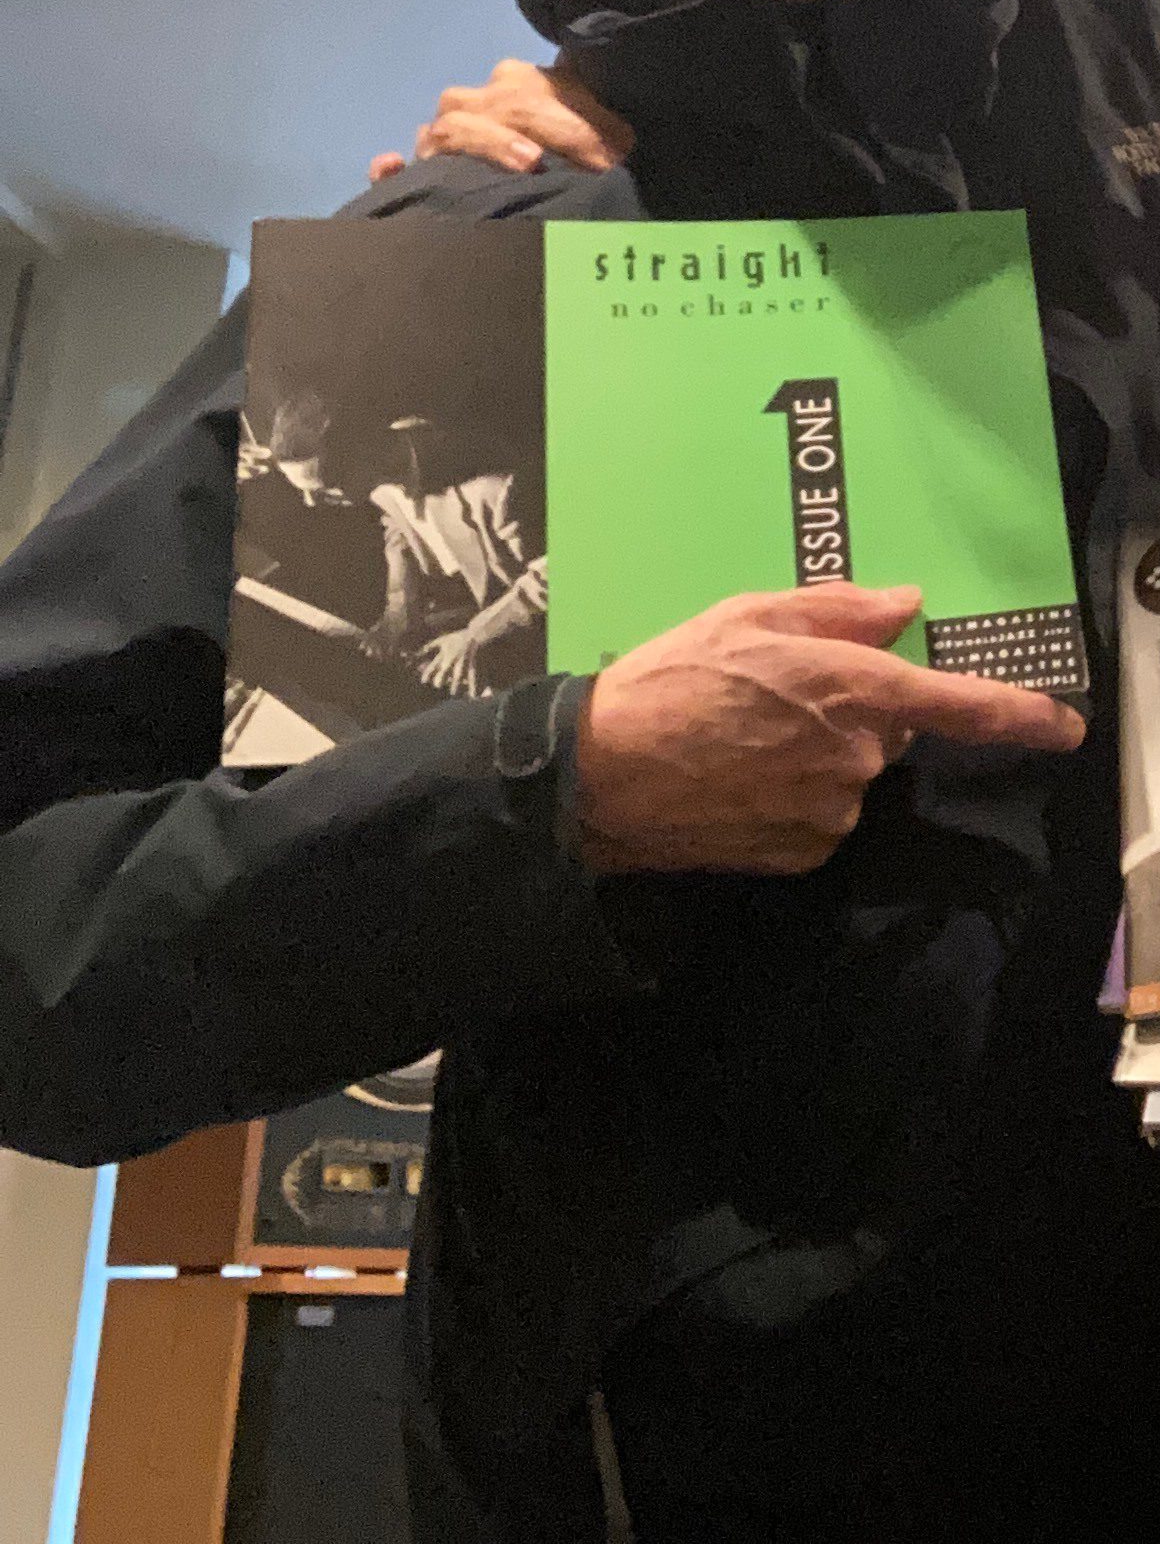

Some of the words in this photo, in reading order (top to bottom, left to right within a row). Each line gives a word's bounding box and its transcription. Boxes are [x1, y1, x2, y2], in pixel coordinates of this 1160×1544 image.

[594, 241, 829, 289] straight
[610, 302, 658, 318] no
[679, 293, 830, 318] chaser
[793, 396, 837, 473] ONE
[801, 487, 845, 583] ISSUE
[965, 608, 1072, 631] MAGAZINE
